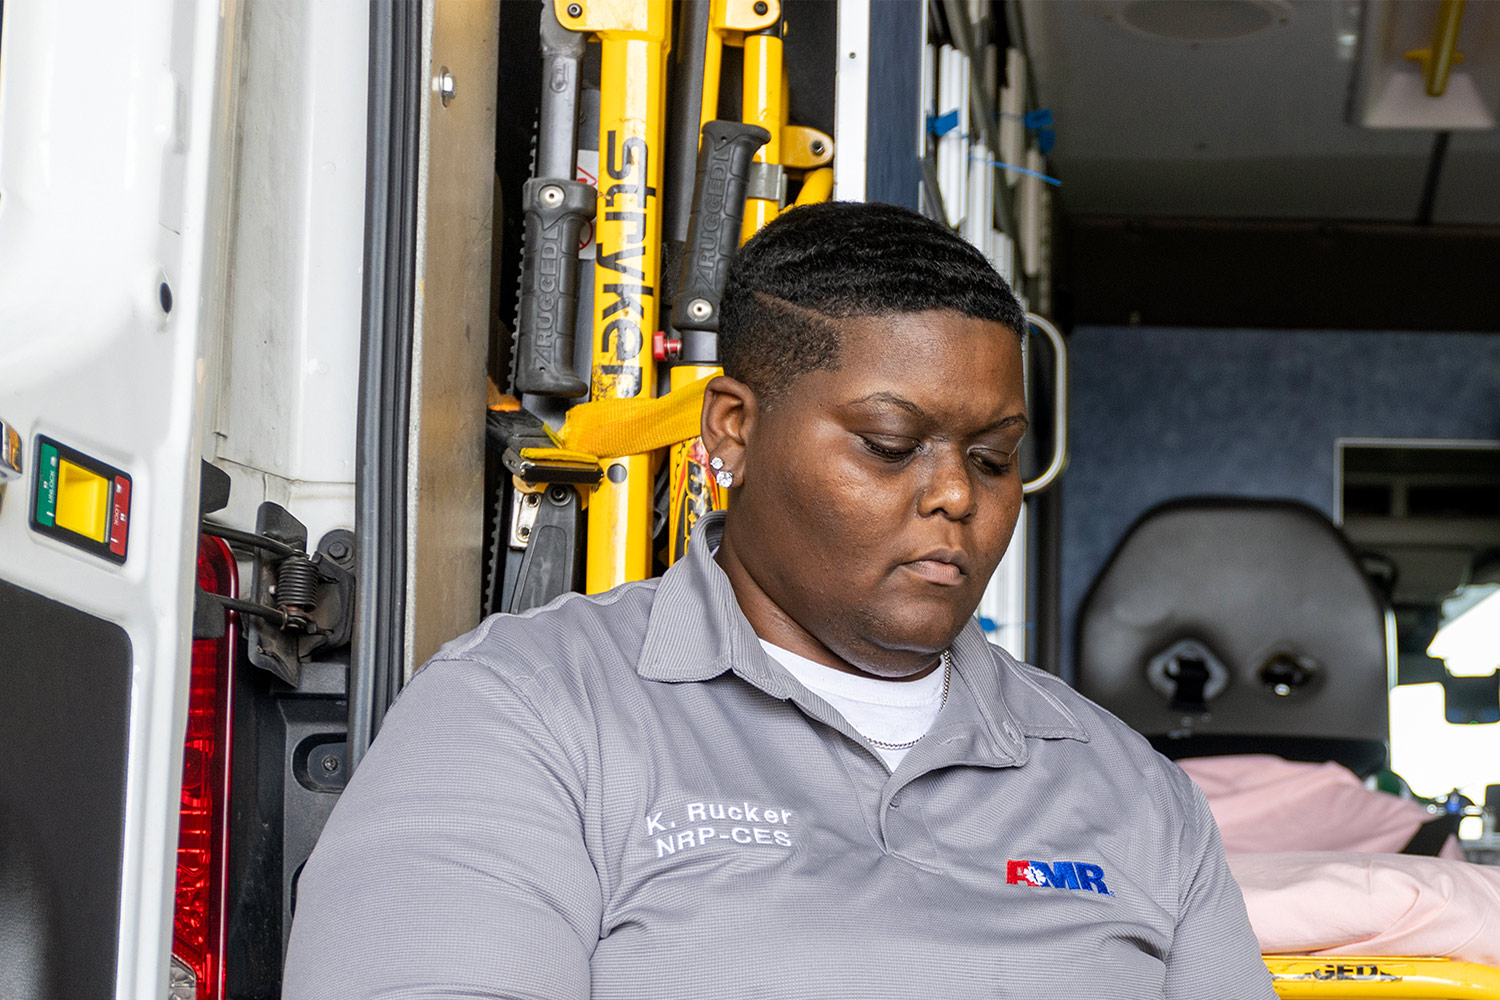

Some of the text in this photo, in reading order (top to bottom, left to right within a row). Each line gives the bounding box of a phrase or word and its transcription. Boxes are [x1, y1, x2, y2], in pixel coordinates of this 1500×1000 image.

[698, 165, 730, 267] RUGGED
[597, 130, 656, 398] stryker
[534, 244, 558, 348] RUGGED
[47, 470, 55, 503] UNLOCK
[646, 802, 792, 836] K. Rucker
[655, 827, 792, 858] NRP-CES
[1006, 859, 1110, 896] AMR
